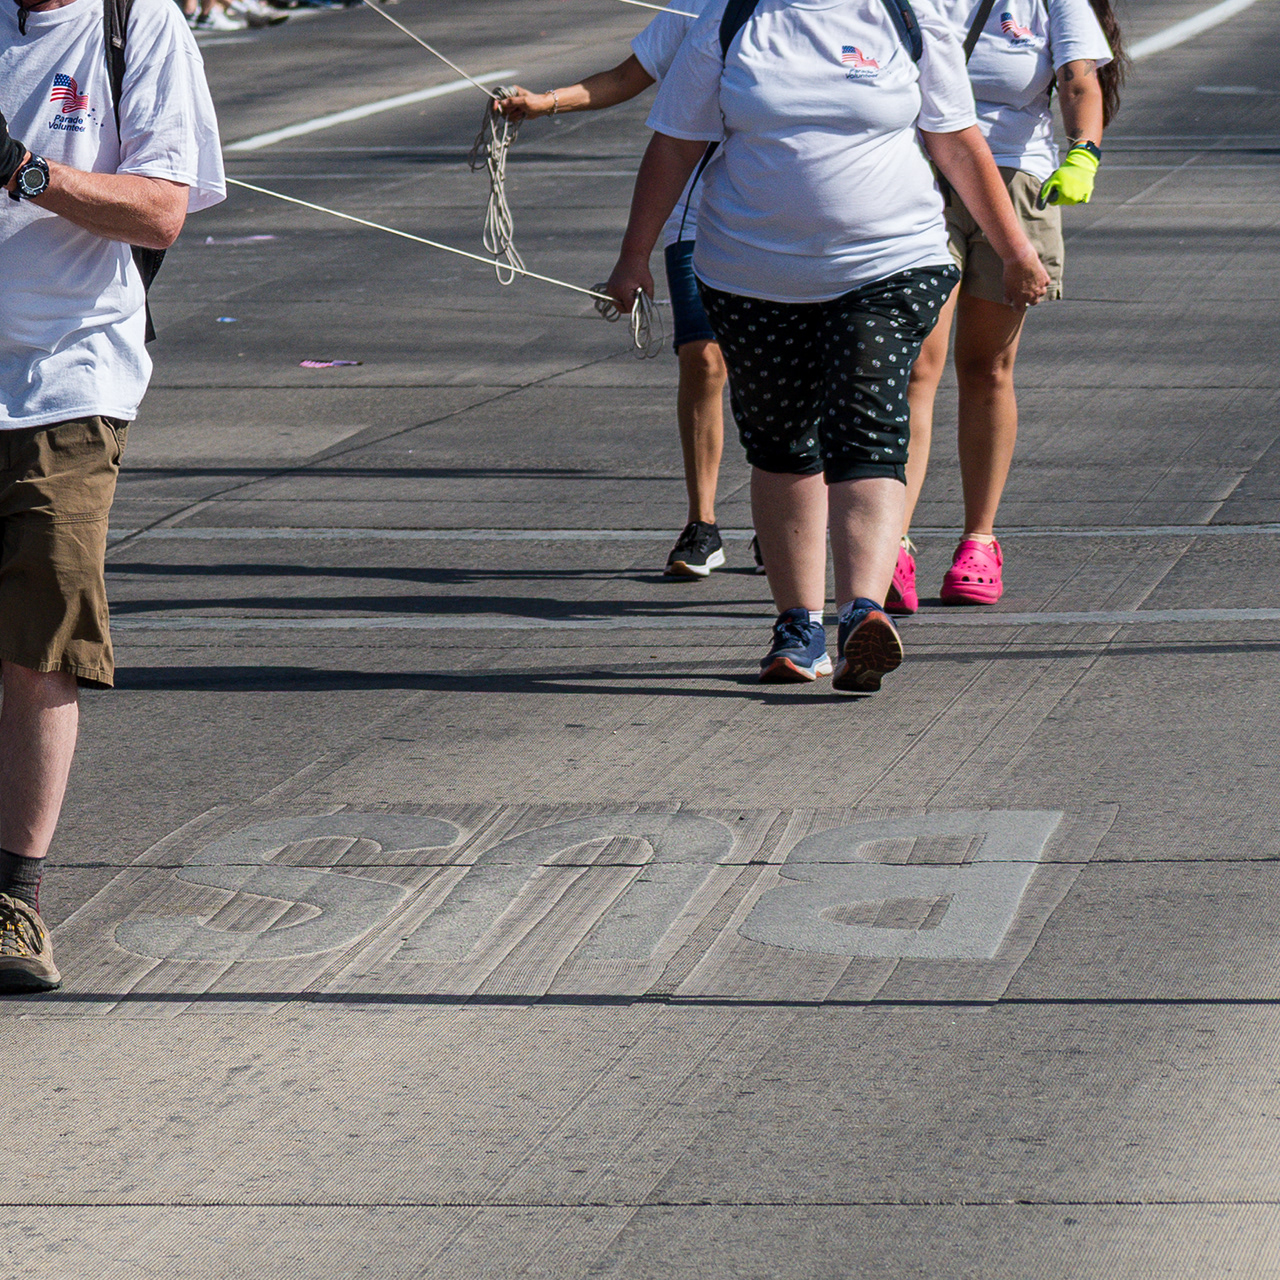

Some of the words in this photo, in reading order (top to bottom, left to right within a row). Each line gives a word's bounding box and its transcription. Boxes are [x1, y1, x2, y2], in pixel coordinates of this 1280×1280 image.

[53, 114, 84, 125] Parade
[48, 121, 86, 132] Volunteer
[113, 808, 1064, 963] BUS
